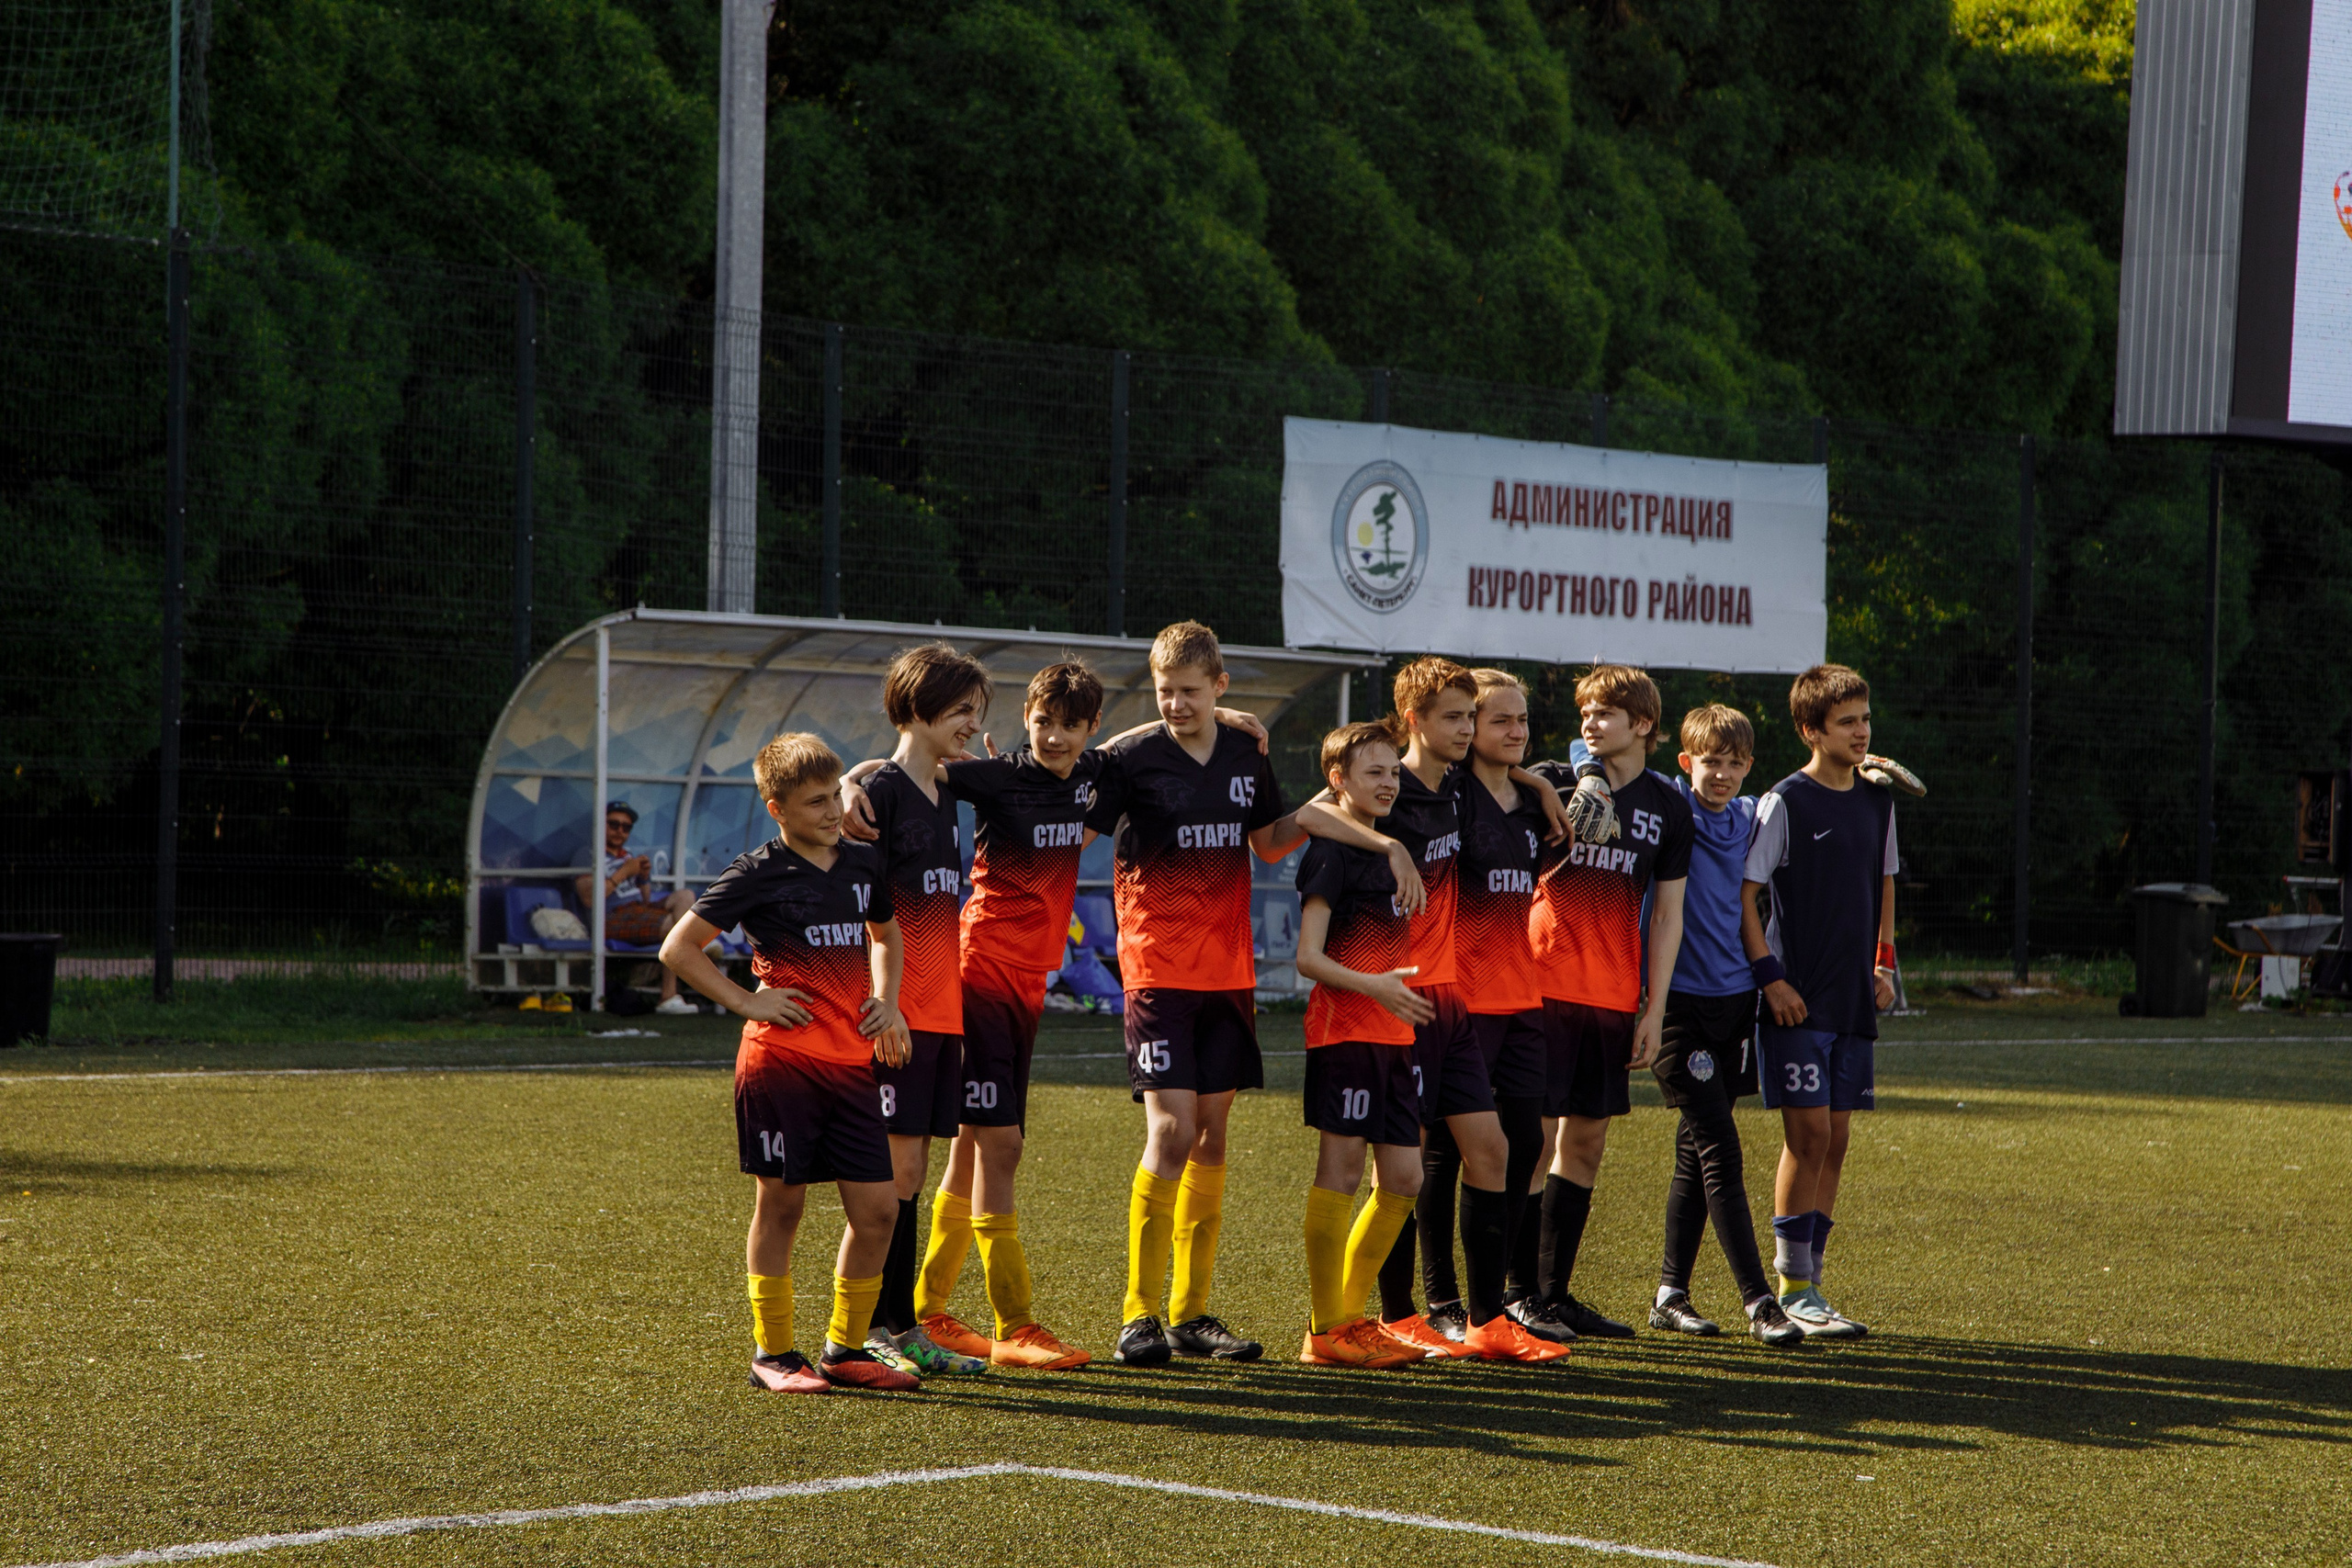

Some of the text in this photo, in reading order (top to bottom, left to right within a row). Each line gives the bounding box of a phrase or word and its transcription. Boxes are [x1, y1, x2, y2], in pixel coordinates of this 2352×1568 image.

[1491, 479, 1734, 544] АДМИНИСТРАЦИЯ
[1468, 566, 1753, 626] КУРОРТНОГО РАЙОНА
[1228, 776, 1255, 807] 45
[1034, 821, 1084, 848] СТАРК
[1177, 822, 1242, 849] СТАРК
[1631, 808, 1663, 845] 55
[1570, 842, 1638, 875] СТАРК
[804, 922, 864, 947] СТАРК
[1137, 1039, 1171, 1074] 45
[1784, 1063, 1821, 1092] 33
[966, 1081, 997, 1109] 20
[1341, 1088, 1371, 1121] 10
